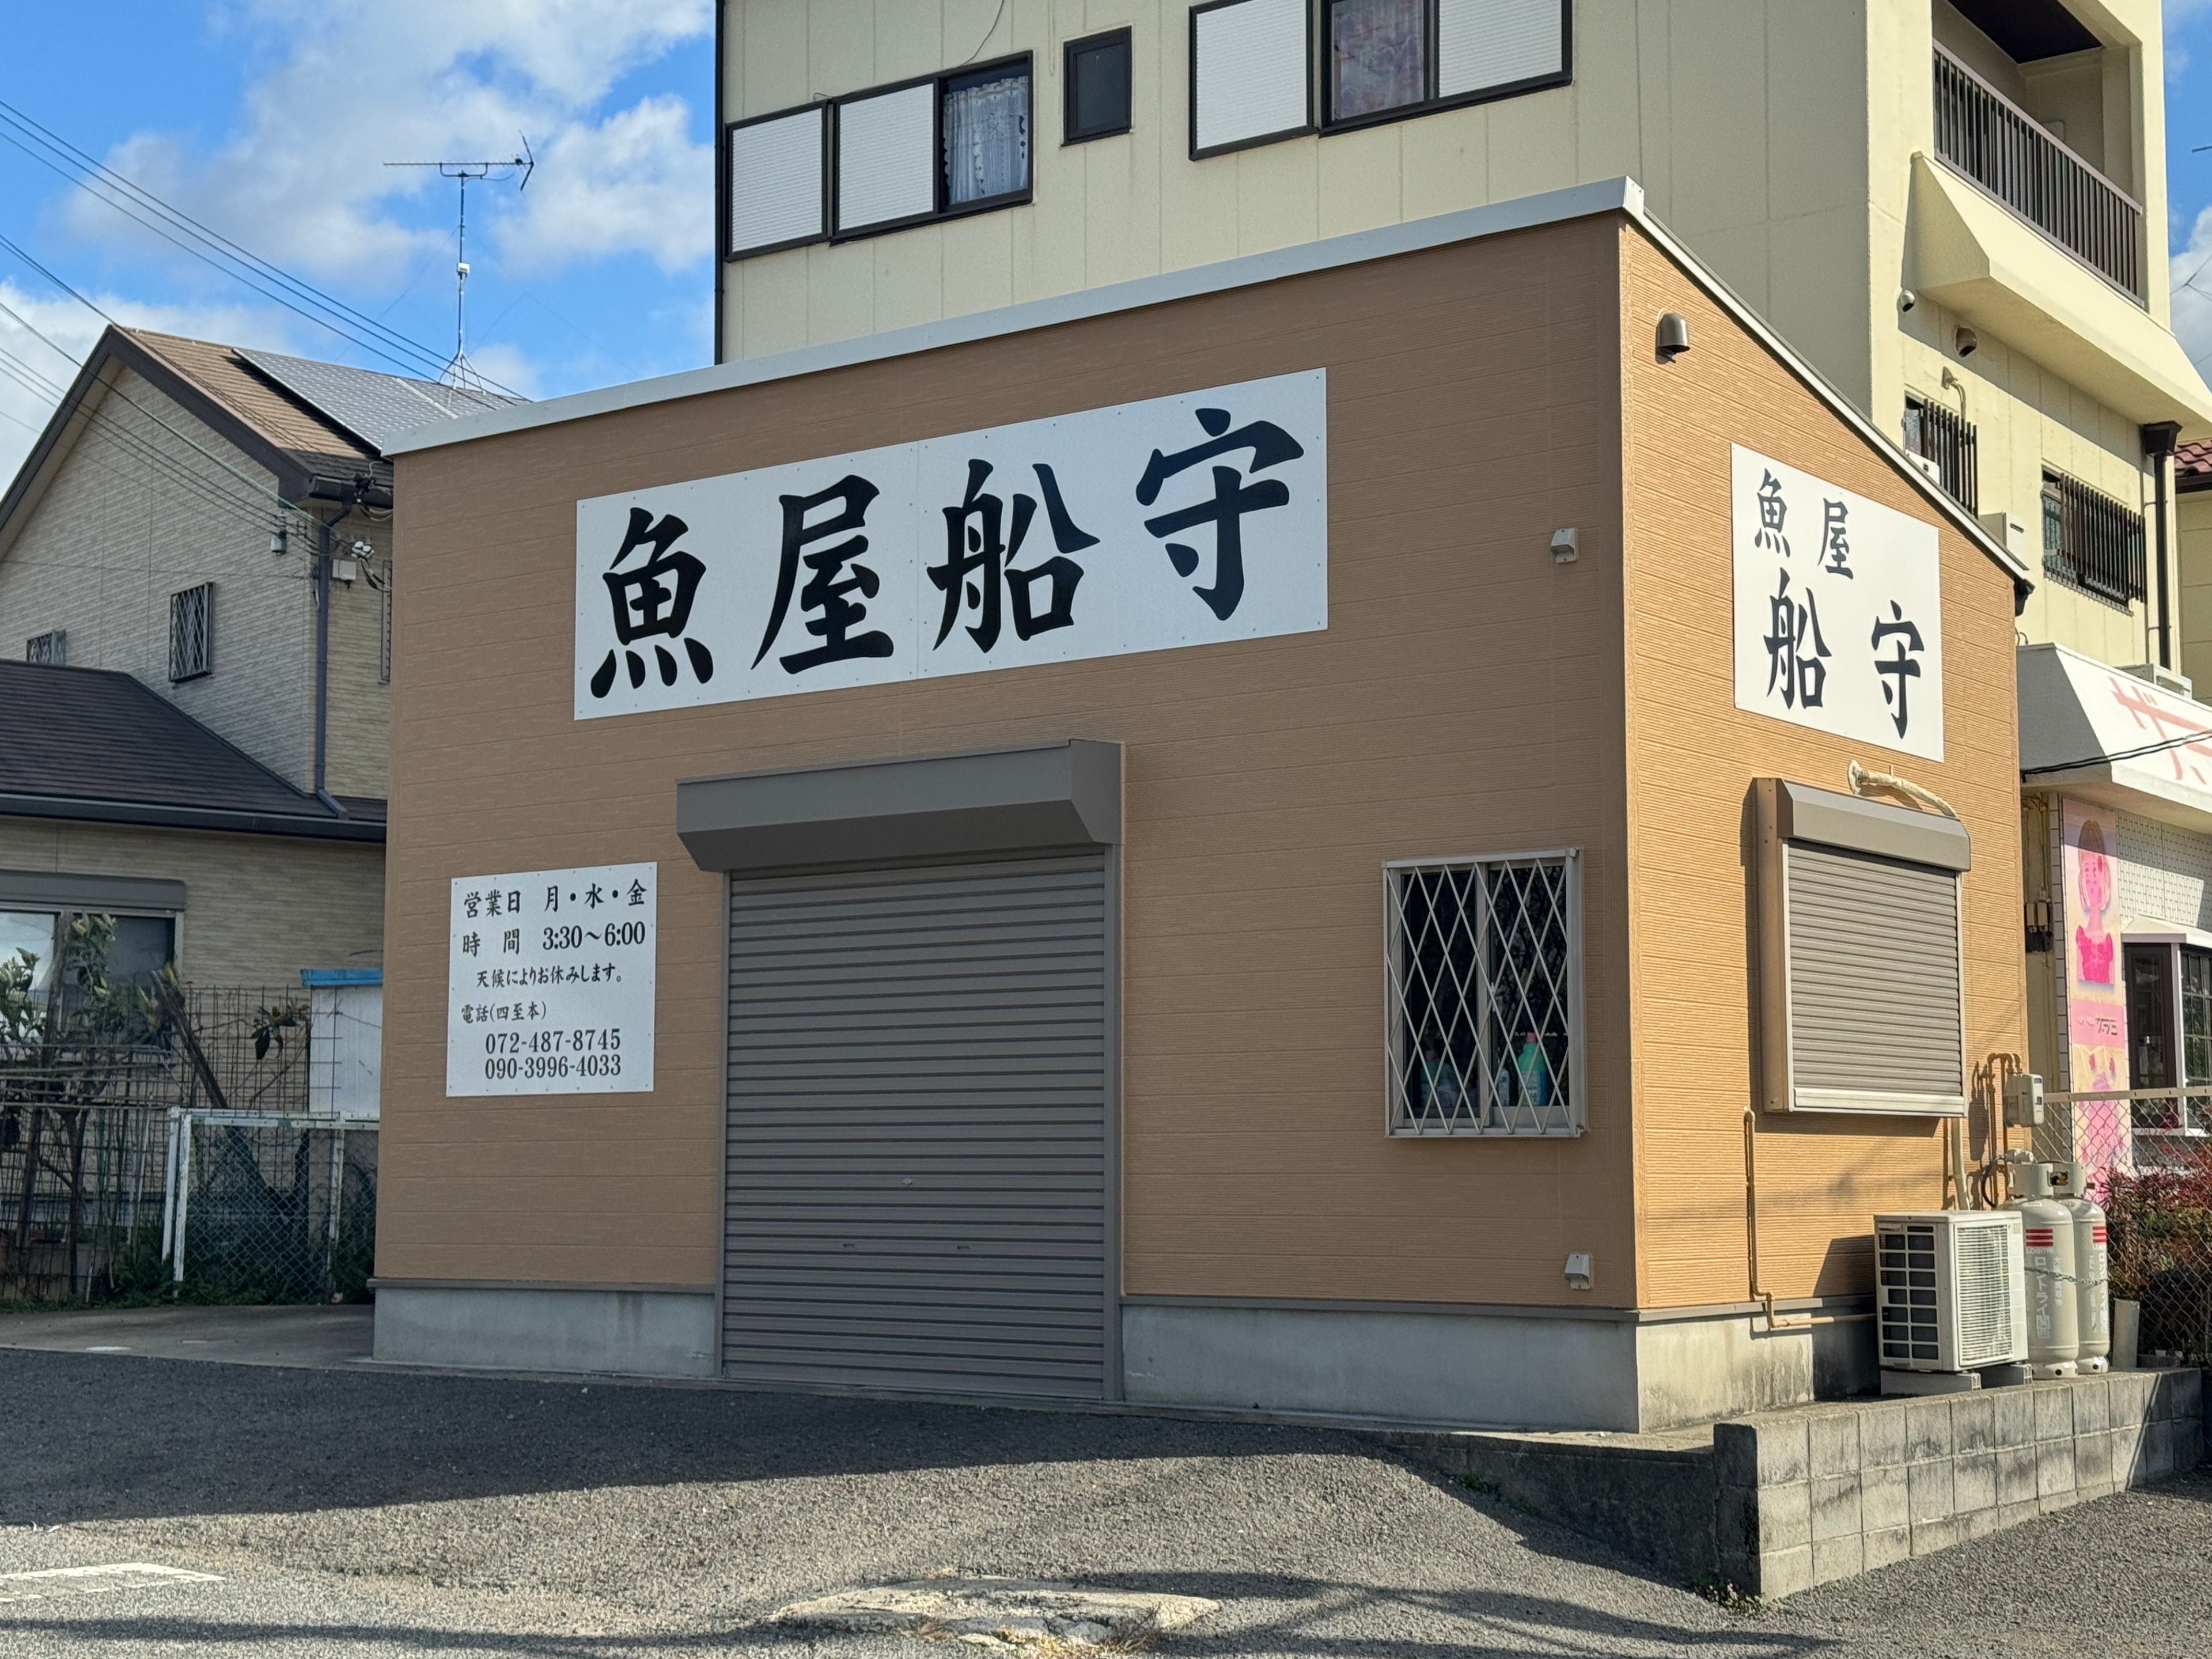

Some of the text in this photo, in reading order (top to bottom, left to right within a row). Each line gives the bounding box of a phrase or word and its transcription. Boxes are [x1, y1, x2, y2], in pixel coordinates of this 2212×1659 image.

[1755, 469, 1853, 578] 魚屋
[589, 408, 1304, 698] 魚屋船守
[1764, 567, 1924, 739] 船守
[464, 878, 647, 918] 営業日 月・水・金
[478, 963, 621, 987] 天候によりお休みします。
[486, 1028, 620, 1054] 072-487-8745
[486, 1054, 620, 1079] 090-3996-4033
